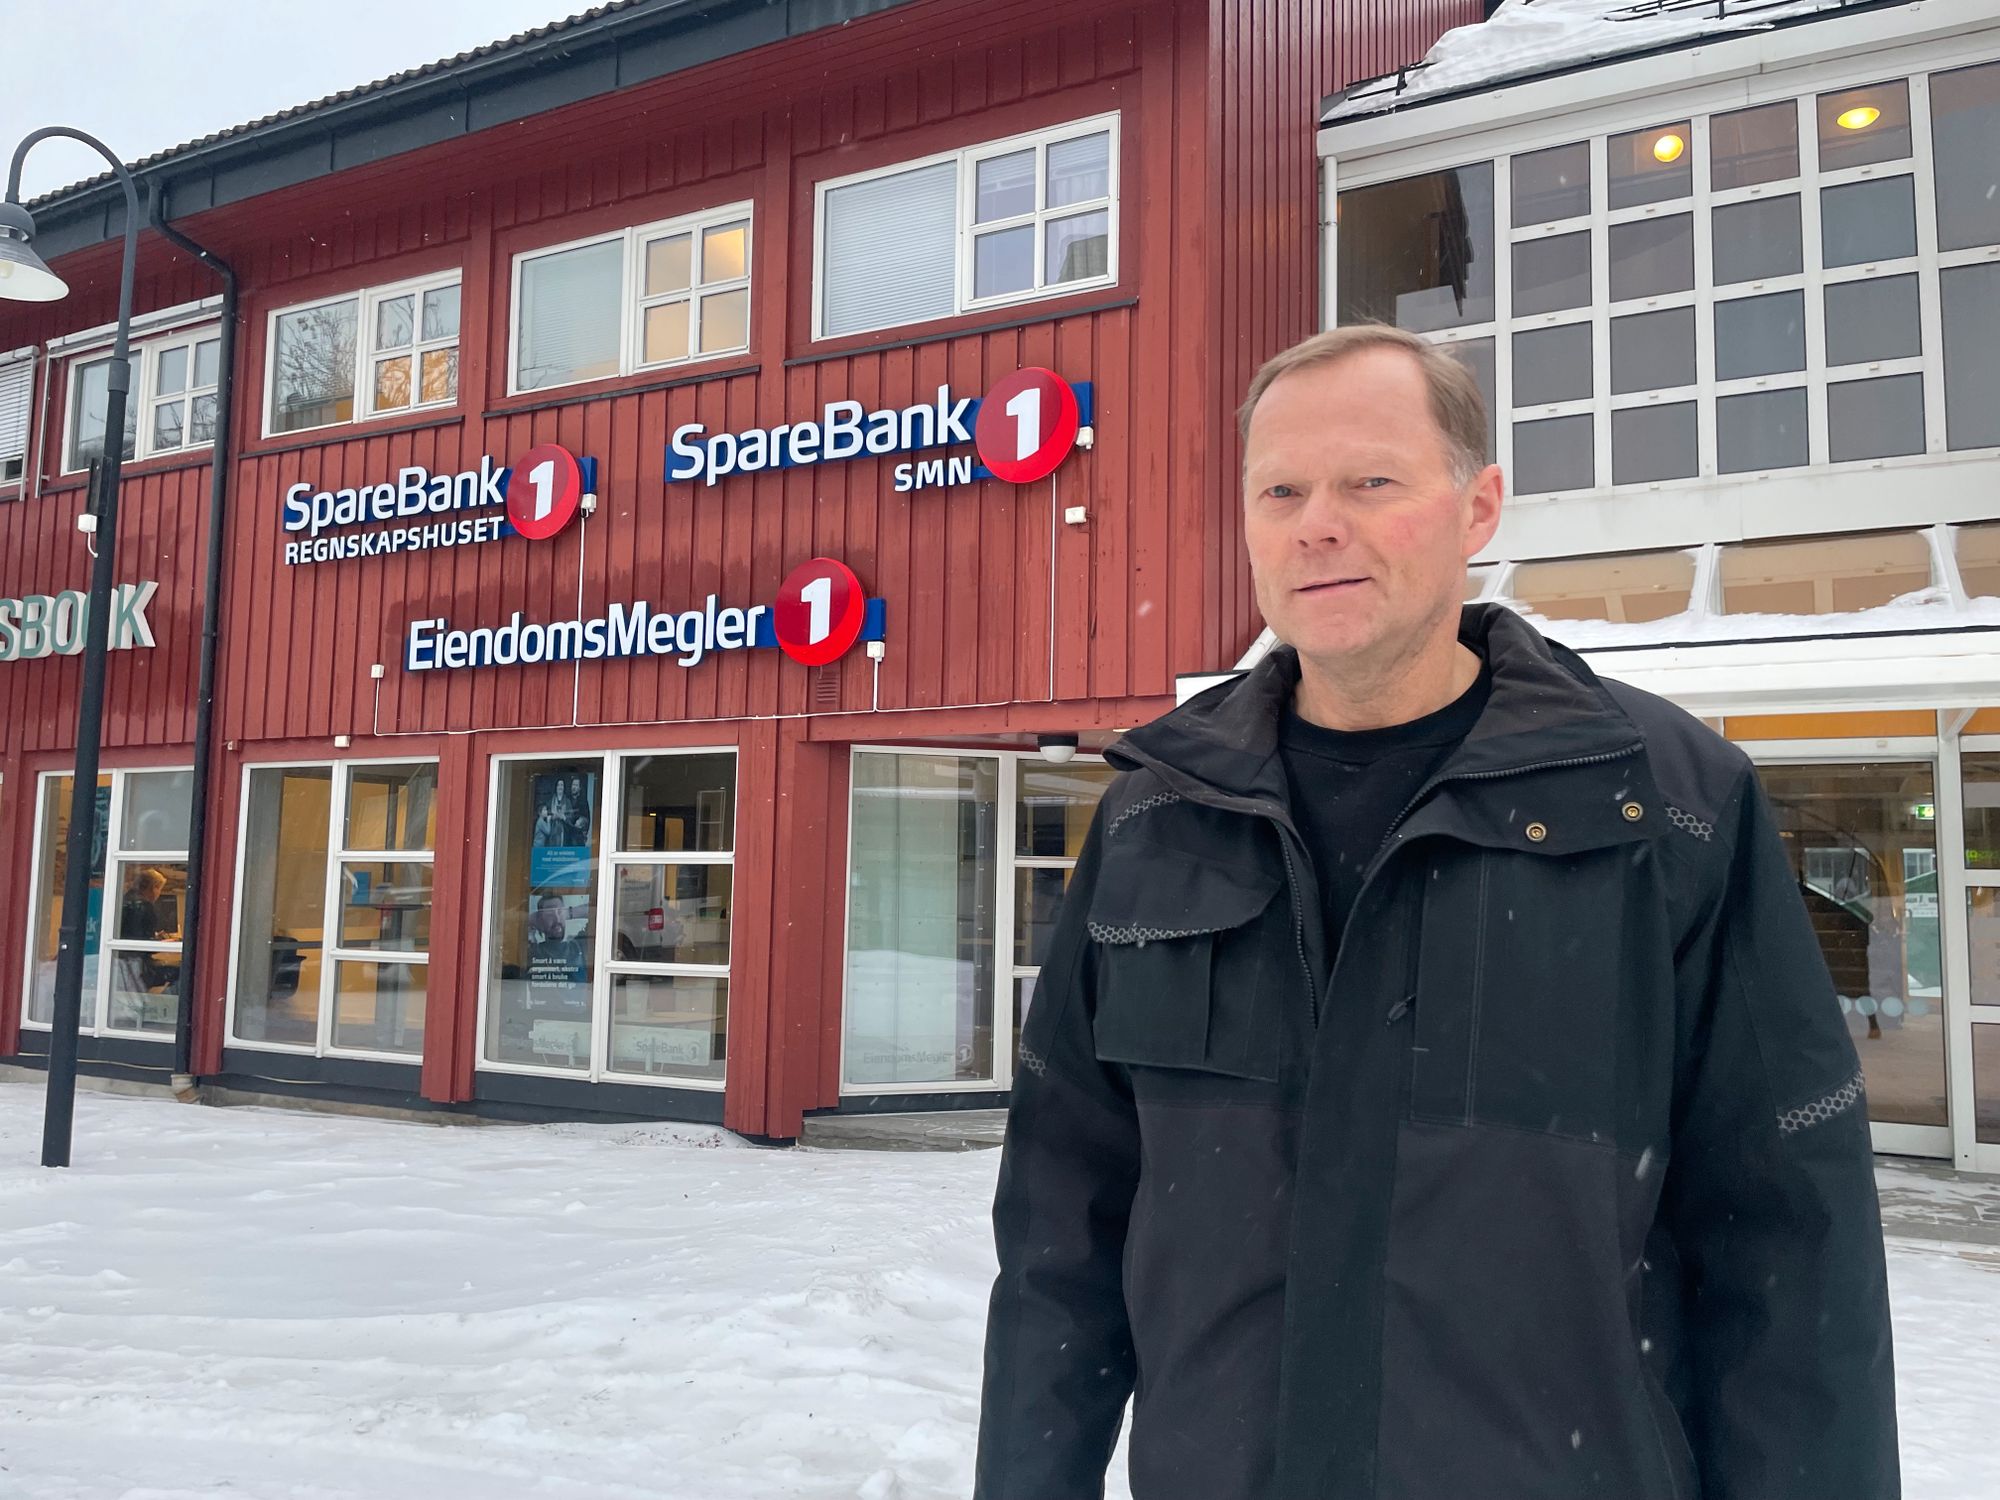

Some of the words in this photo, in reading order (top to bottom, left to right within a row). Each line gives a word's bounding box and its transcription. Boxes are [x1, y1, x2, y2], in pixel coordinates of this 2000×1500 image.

[672, 384, 971, 486] SpareBank
[1006, 387, 1041, 461] 1
[285, 455, 505, 537] SpareBank
[529, 460, 554, 521] 1
[894, 455, 971, 492] SMN
[285, 516, 504, 565] REGNSKAPSHUSET
[409, 594, 765, 668] EiendomsMegler
[801, 577, 832, 645] 1
[635, 1039, 684, 1056] SpeBank
